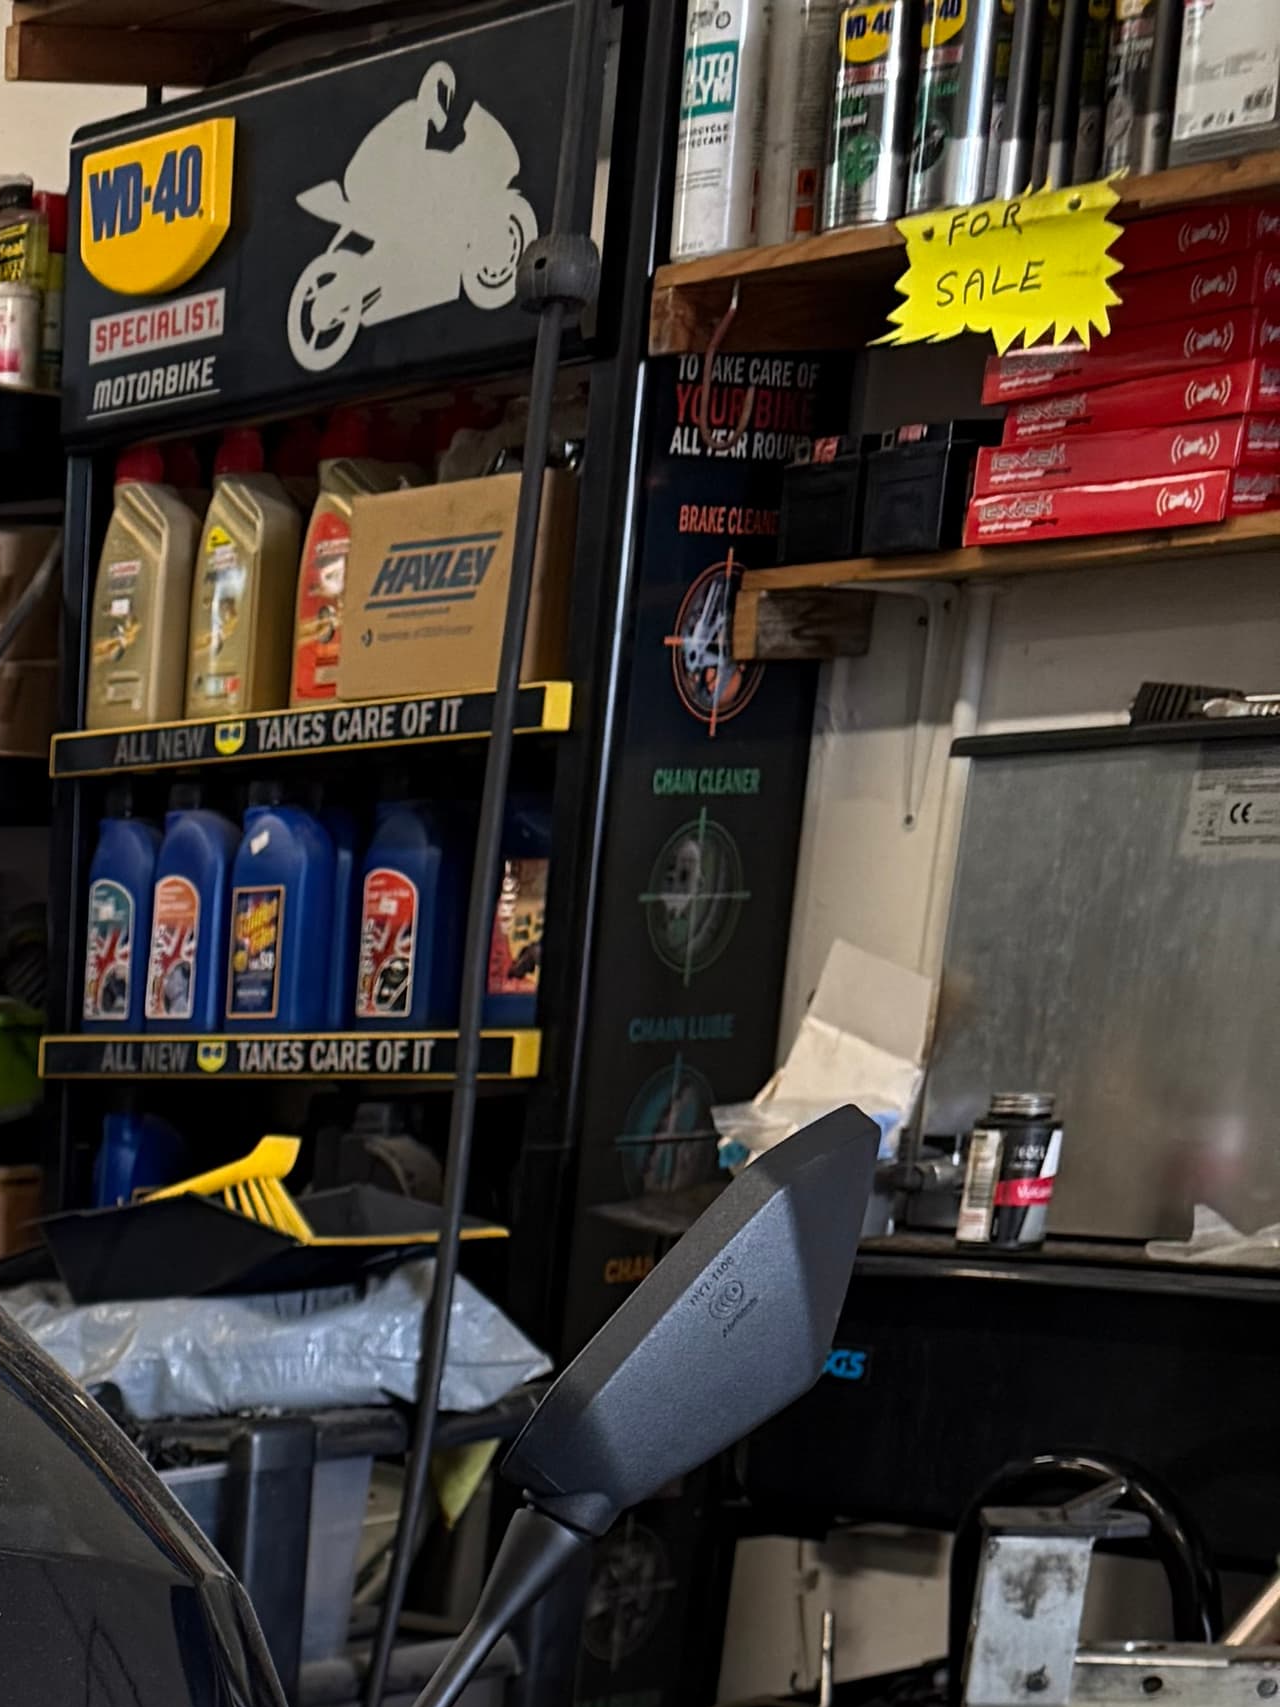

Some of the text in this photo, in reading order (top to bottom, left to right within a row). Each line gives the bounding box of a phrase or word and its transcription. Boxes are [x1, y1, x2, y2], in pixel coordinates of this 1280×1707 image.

[88, 143, 203, 243] WD-40
[947, 203, 1024, 246] FOR
[936, 261, 1046, 308] SALE
[94, 298, 219, 354] SPECIALIST
[93, 355, 216, 411] MOTORBIKE
[676, 354, 699, 382] TO
[706, 356, 744, 384] AKE
[747, 358, 794, 389] CARE
[669, 426, 701, 457] ALL
[678, 503, 726, 534] BRAKE
[369, 545, 497, 597] HAYLEY
[114, 734, 152, 766] ALL
[156, 729, 205, 761] NEW
[256, 710, 327, 753] TAKES
[331, 703, 396, 745] CARE
[400, 700, 435, 736] OF
[438, 697, 463, 733] IT
[653, 767, 761, 795] CHAIN CLEANER
[100, 1040, 137, 1073] ALL
[140, 1040, 189, 1072] NEW
[237, 1038, 306, 1074] TAKES
[309, 1037, 370, 1073] CARE
[375, 1038, 408, 1072] OF
[413, 1038, 436, 1072] IT
